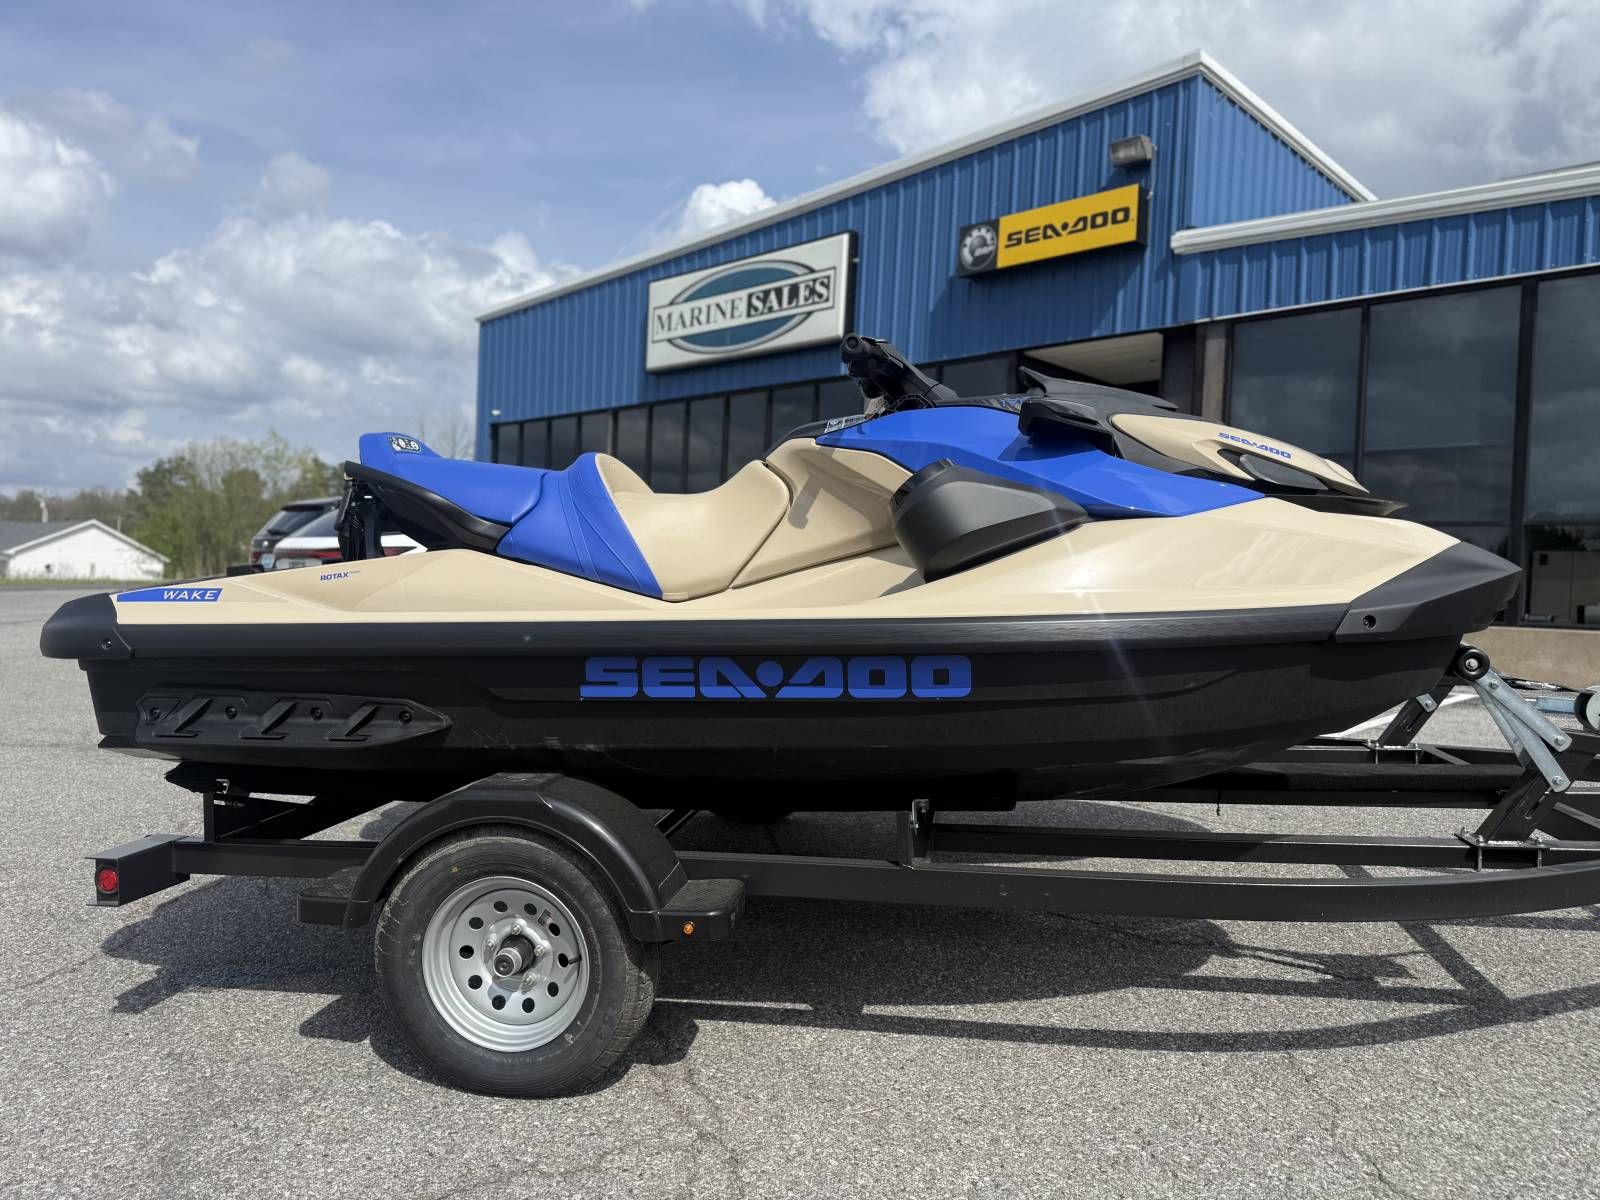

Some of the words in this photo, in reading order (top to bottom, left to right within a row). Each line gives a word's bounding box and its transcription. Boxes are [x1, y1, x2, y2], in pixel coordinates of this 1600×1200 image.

[655, 297, 744, 333] MARINE
[750, 277, 829, 315] SALES
[320, 572, 349, 581] ROTAX
[163, 590, 218, 600] WAKE
